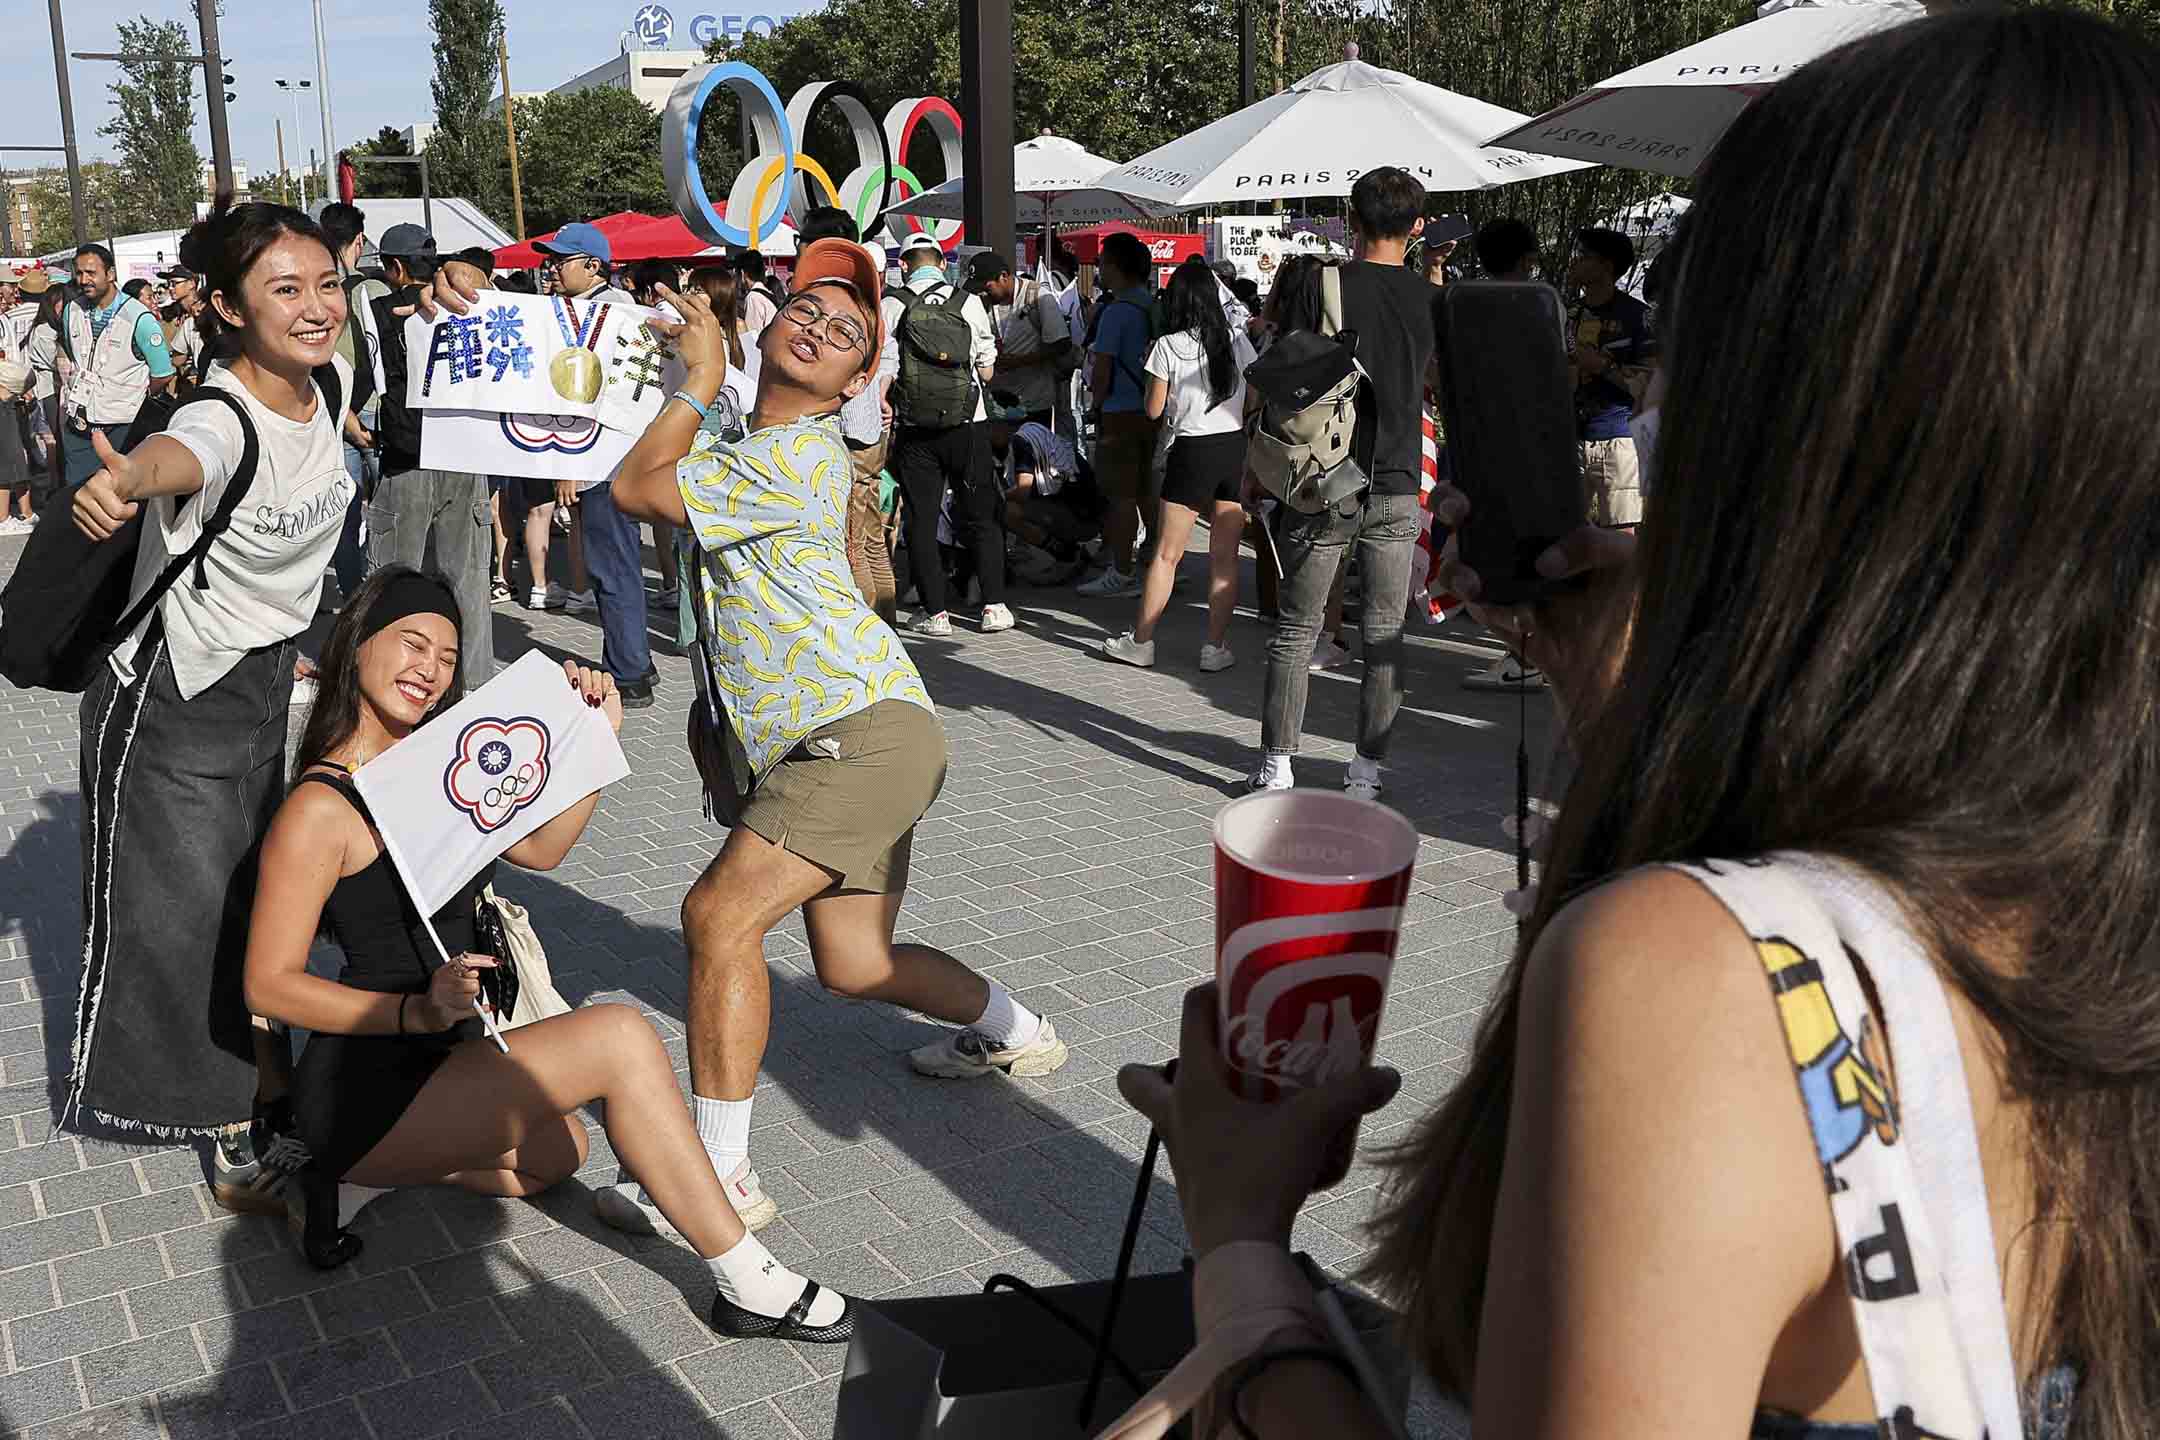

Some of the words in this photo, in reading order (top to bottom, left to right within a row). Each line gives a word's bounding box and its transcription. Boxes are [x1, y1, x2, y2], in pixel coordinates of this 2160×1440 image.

[1345, 166, 1432, 182] 24
[1230, 226, 1245, 235] THE
[1230, 246, 1242, 256] TO
[565, 355, 586, 393] 1
